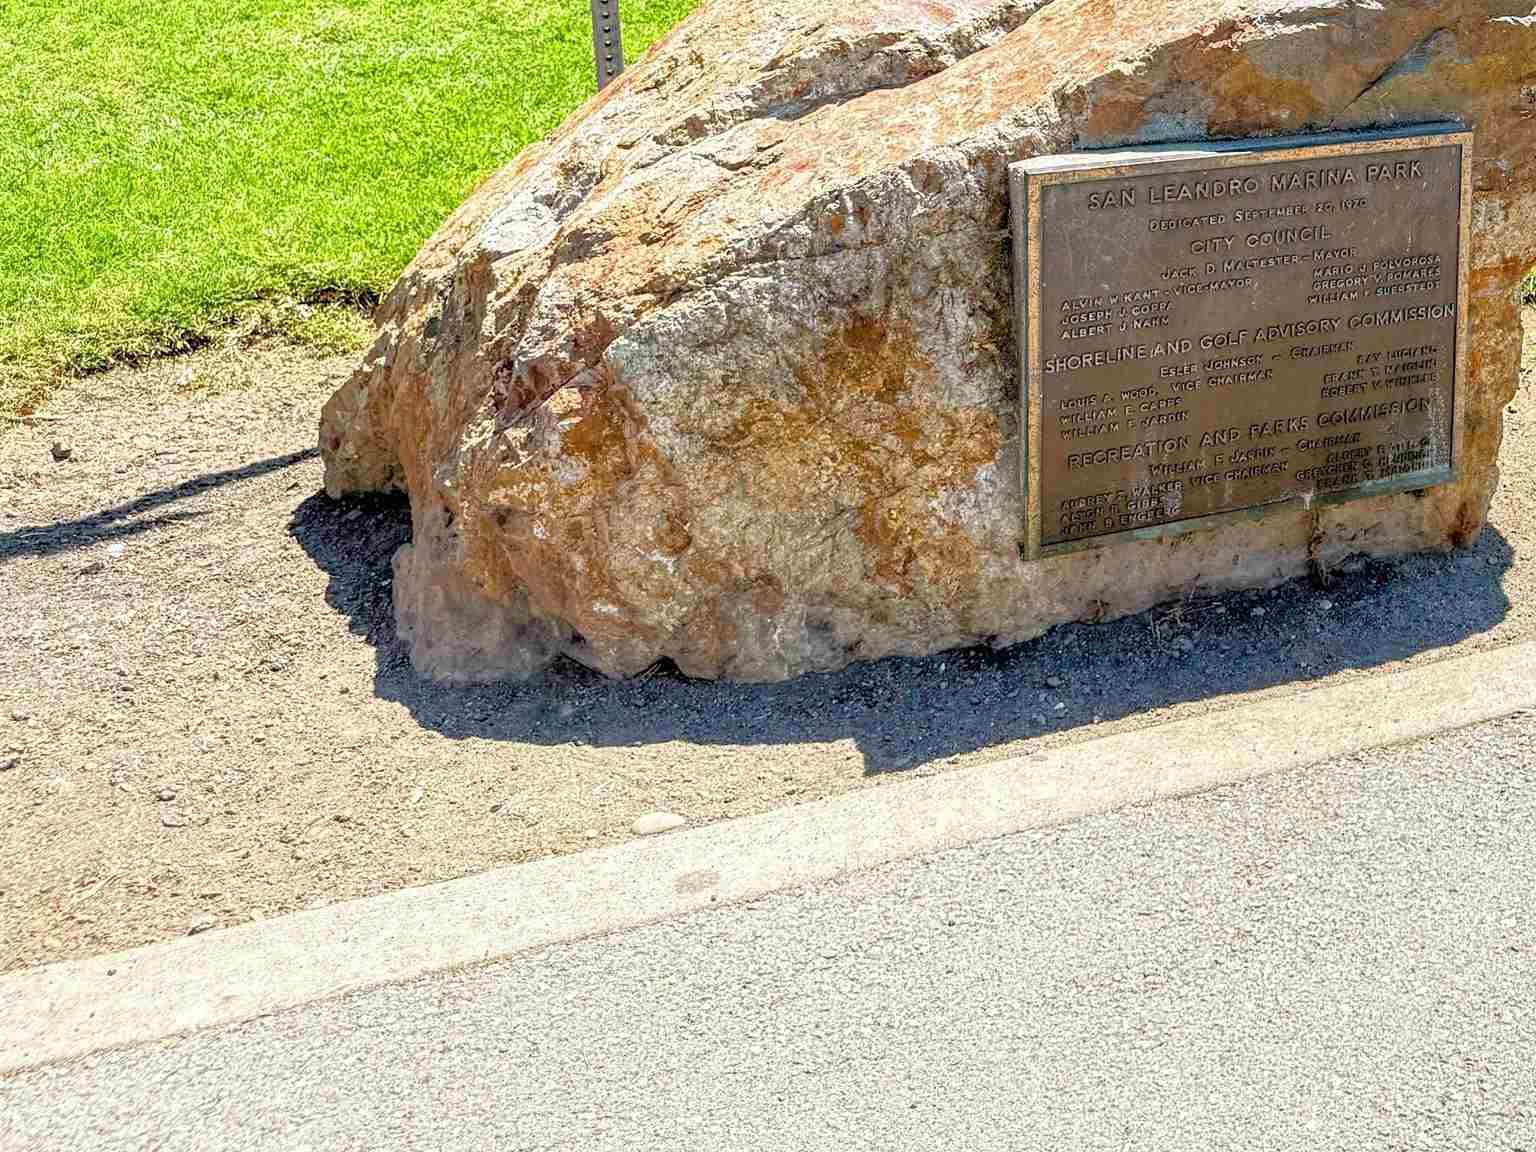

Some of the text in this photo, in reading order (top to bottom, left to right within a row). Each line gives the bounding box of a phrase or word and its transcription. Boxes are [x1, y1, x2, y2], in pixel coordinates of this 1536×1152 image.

[1088, 160, 1424, 210] SAN LEANDRO MARINA PARK
[1149, 214, 1226, 232] DEDICATED
[1235, 203, 1308, 222] SEPTEMBER
[1191, 223, 1331, 255] CITY COUNCIL
[1160, 267, 1198, 281] JACK
[1313, 248, 1358, 262] MAYOR
[1313, 265, 1354, 279] MARIO
[1312, 275, 1368, 291] GREGORY
[1307, 290, 1359, 305] WILLIAM
[1062, 310, 1112, 325] JOSEPH
[1045, 303, 1457, 374] SHORELINE AND GOLF ADVISORY COMMISSION
[1062, 324, 1113, 340] ALBERT
[1206, 352, 1264, 372] JOHNSON
[1171, 380, 1202, 393] VICE
[1060, 408, 1118, 425] WILLIAM
[1060, 423, 1120, 441] WILLIAM
[1067, 397, 1434, 469] RECREATION AND PARKS COMMISSION
